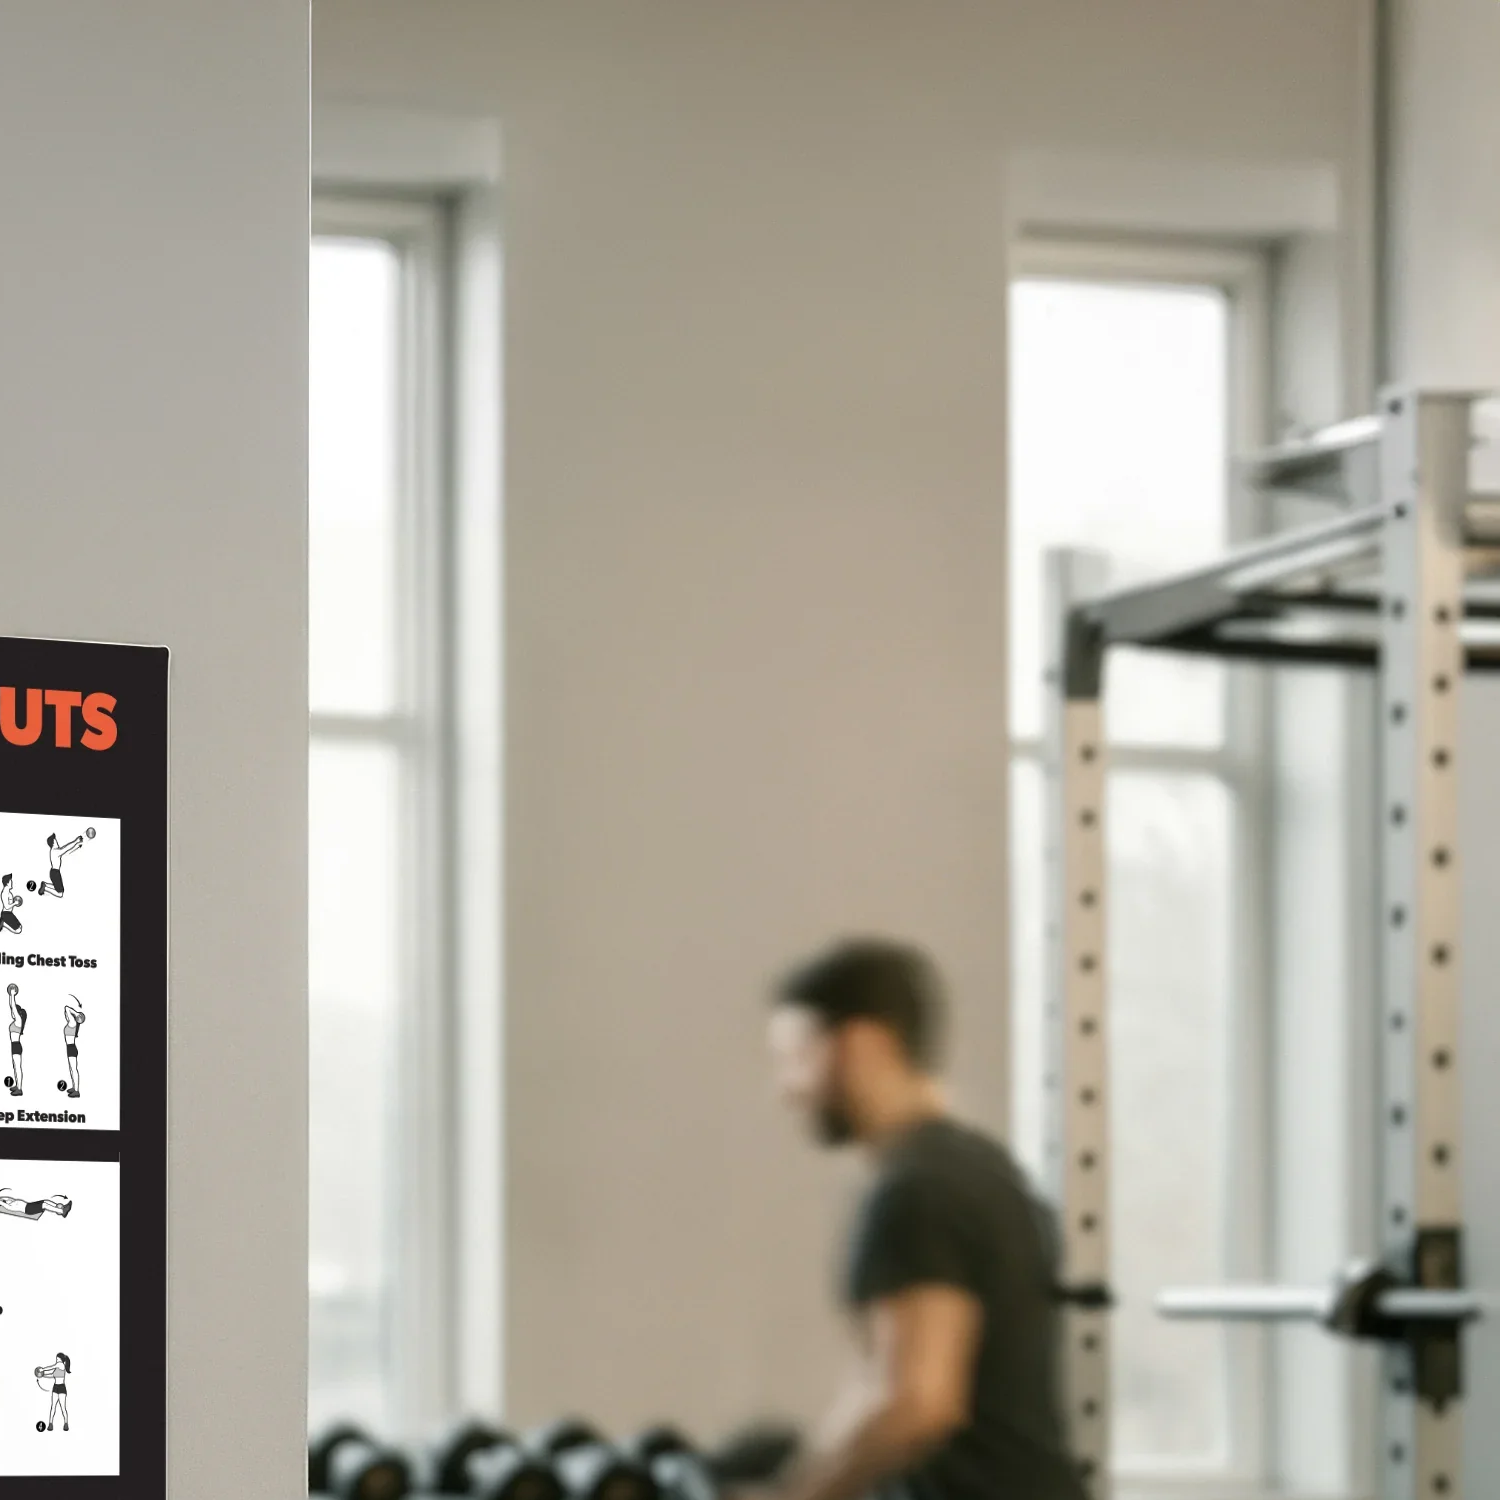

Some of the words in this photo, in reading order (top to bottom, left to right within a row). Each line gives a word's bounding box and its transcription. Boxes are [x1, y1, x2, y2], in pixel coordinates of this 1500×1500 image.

[27, 954, 66, 967] Chest
[68, 955, 97, 968] Toss
[17, 1110, 86, 1123] Extension
